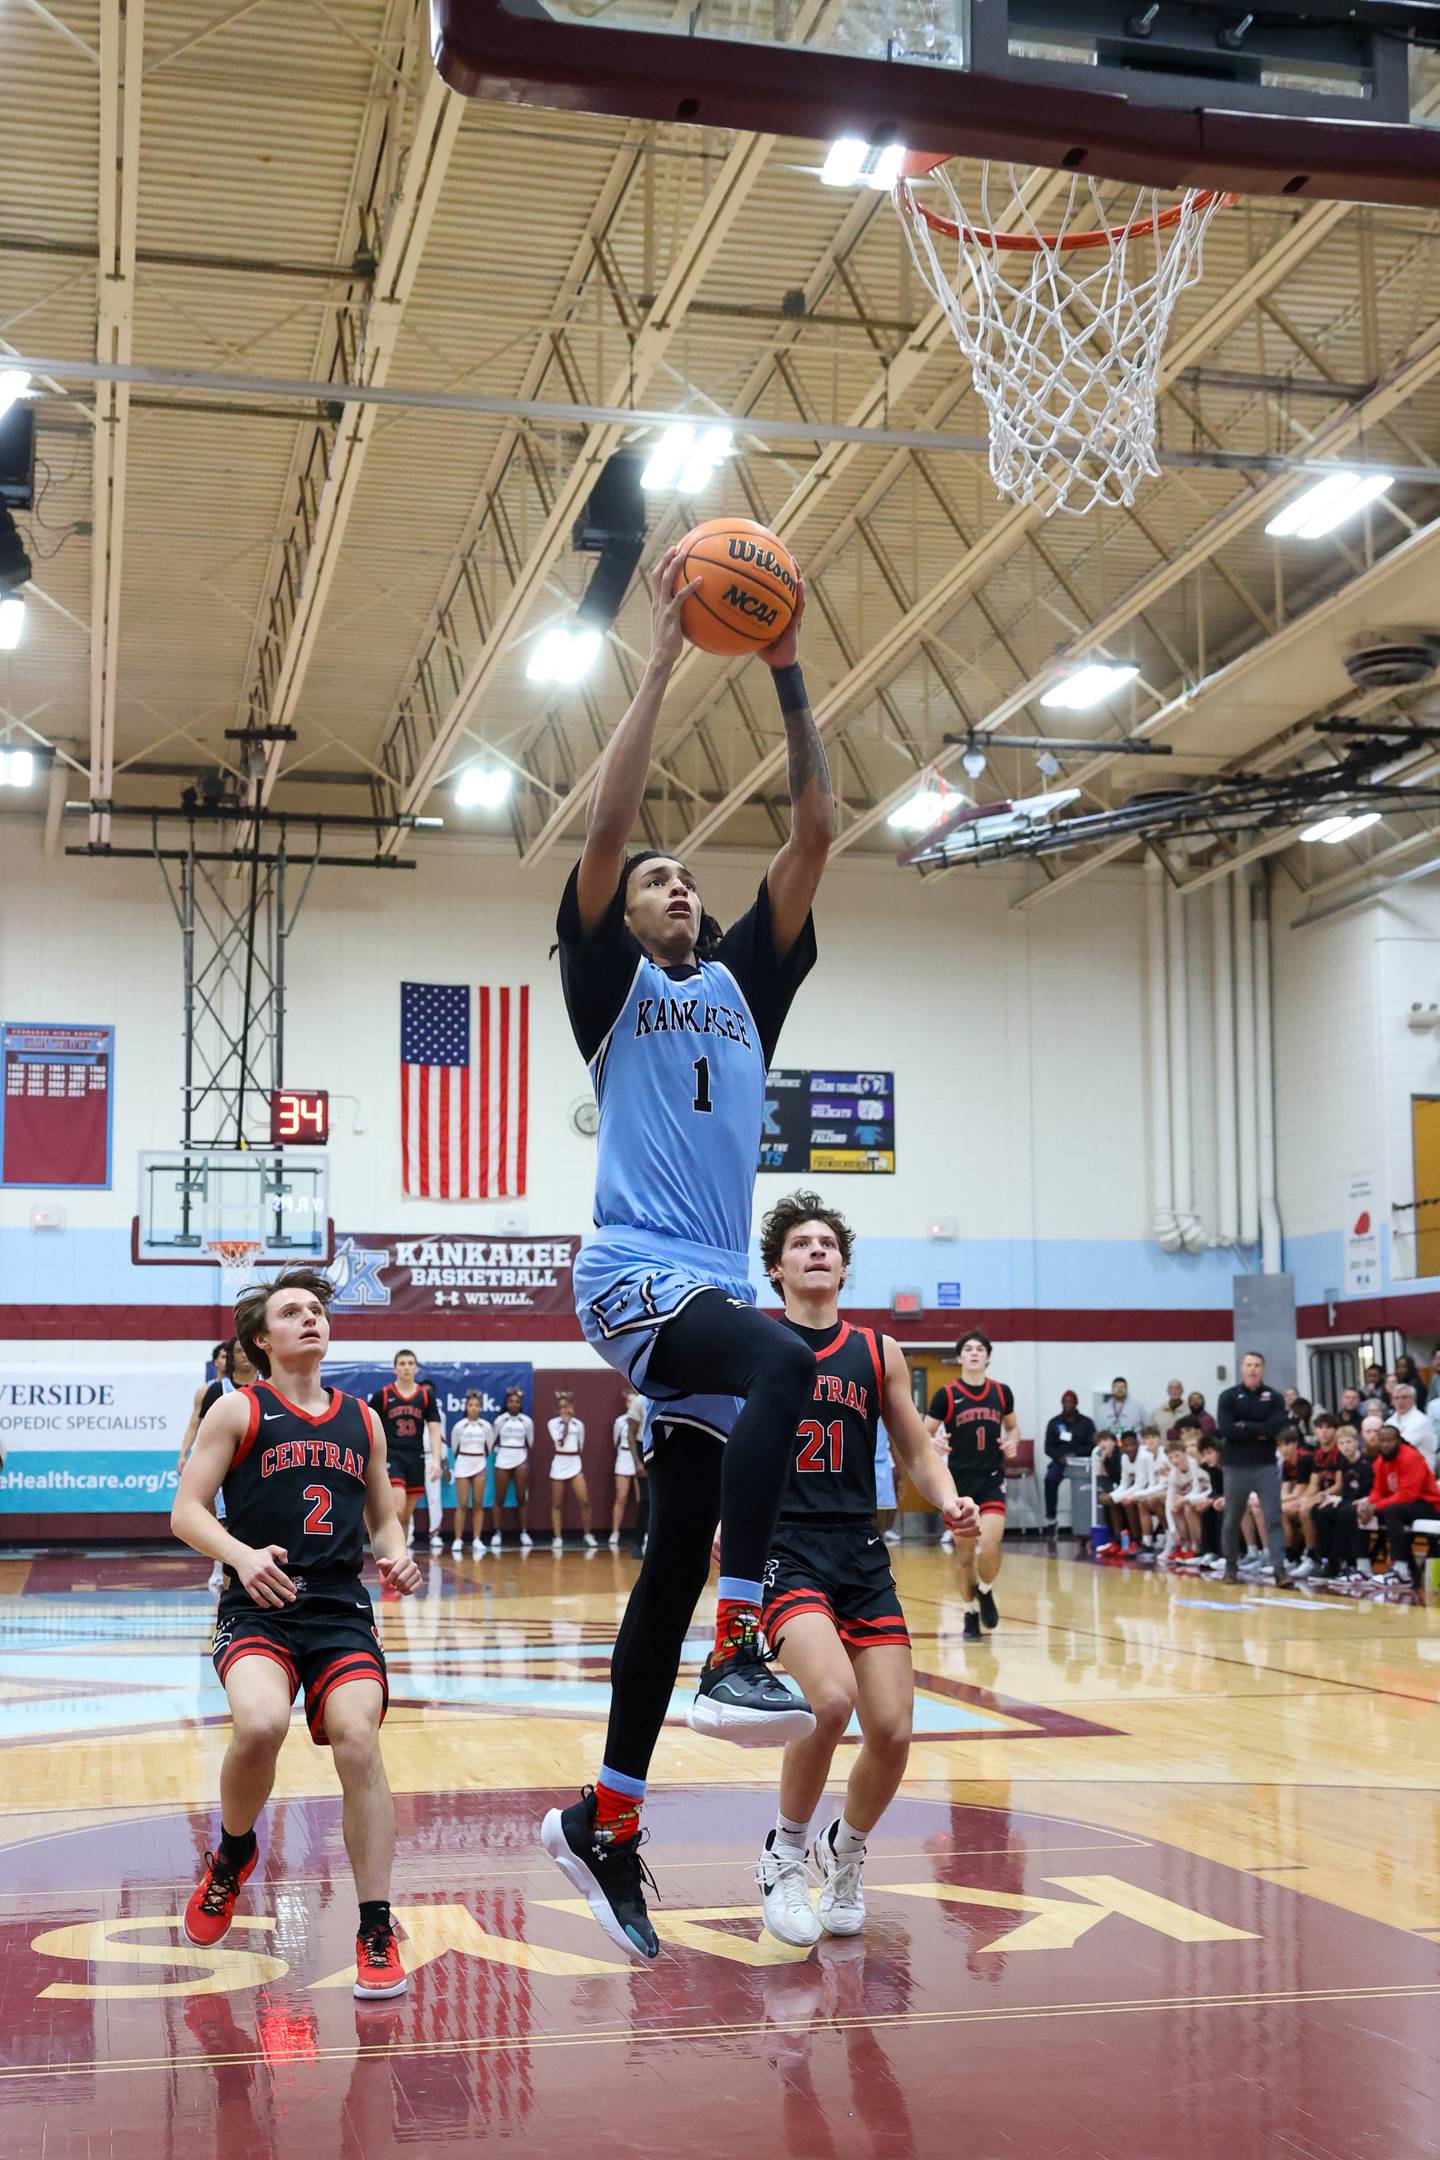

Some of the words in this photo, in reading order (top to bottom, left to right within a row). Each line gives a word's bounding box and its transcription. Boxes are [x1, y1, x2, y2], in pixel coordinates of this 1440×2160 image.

[728, 538, 796, 597] Wilson
[721, 584, 778, 626] NCAA
[635, 997, 752, 1052] KANKAKEE
[692, 1056, 713, 1114] 1
[280, 1097, 323, 1134] 34
[762, 1100, 780, 1134] K
[395, 1242, 572, 1267] KANKAKEE
[337, 1250, 390, 1305] K
[411, 1267, 557, 1287] BASKETBALL
[464, 1292, 489, 1305] WE
[447, 1393, 501, 1412] bak.
[0, 1416, 61, 1430] OPEDIC
[67, 1416, 167, 1430] SPECIALISTS
[976, 1426, 985, 1451] 1
[261, 1440, 366, 1486] CENTRAL
[796, 1420, 843, 1472] 21
[0, 1470, 179, 1493] eHealthcare.org/S
[303, 1484, 333, 1535] 2
